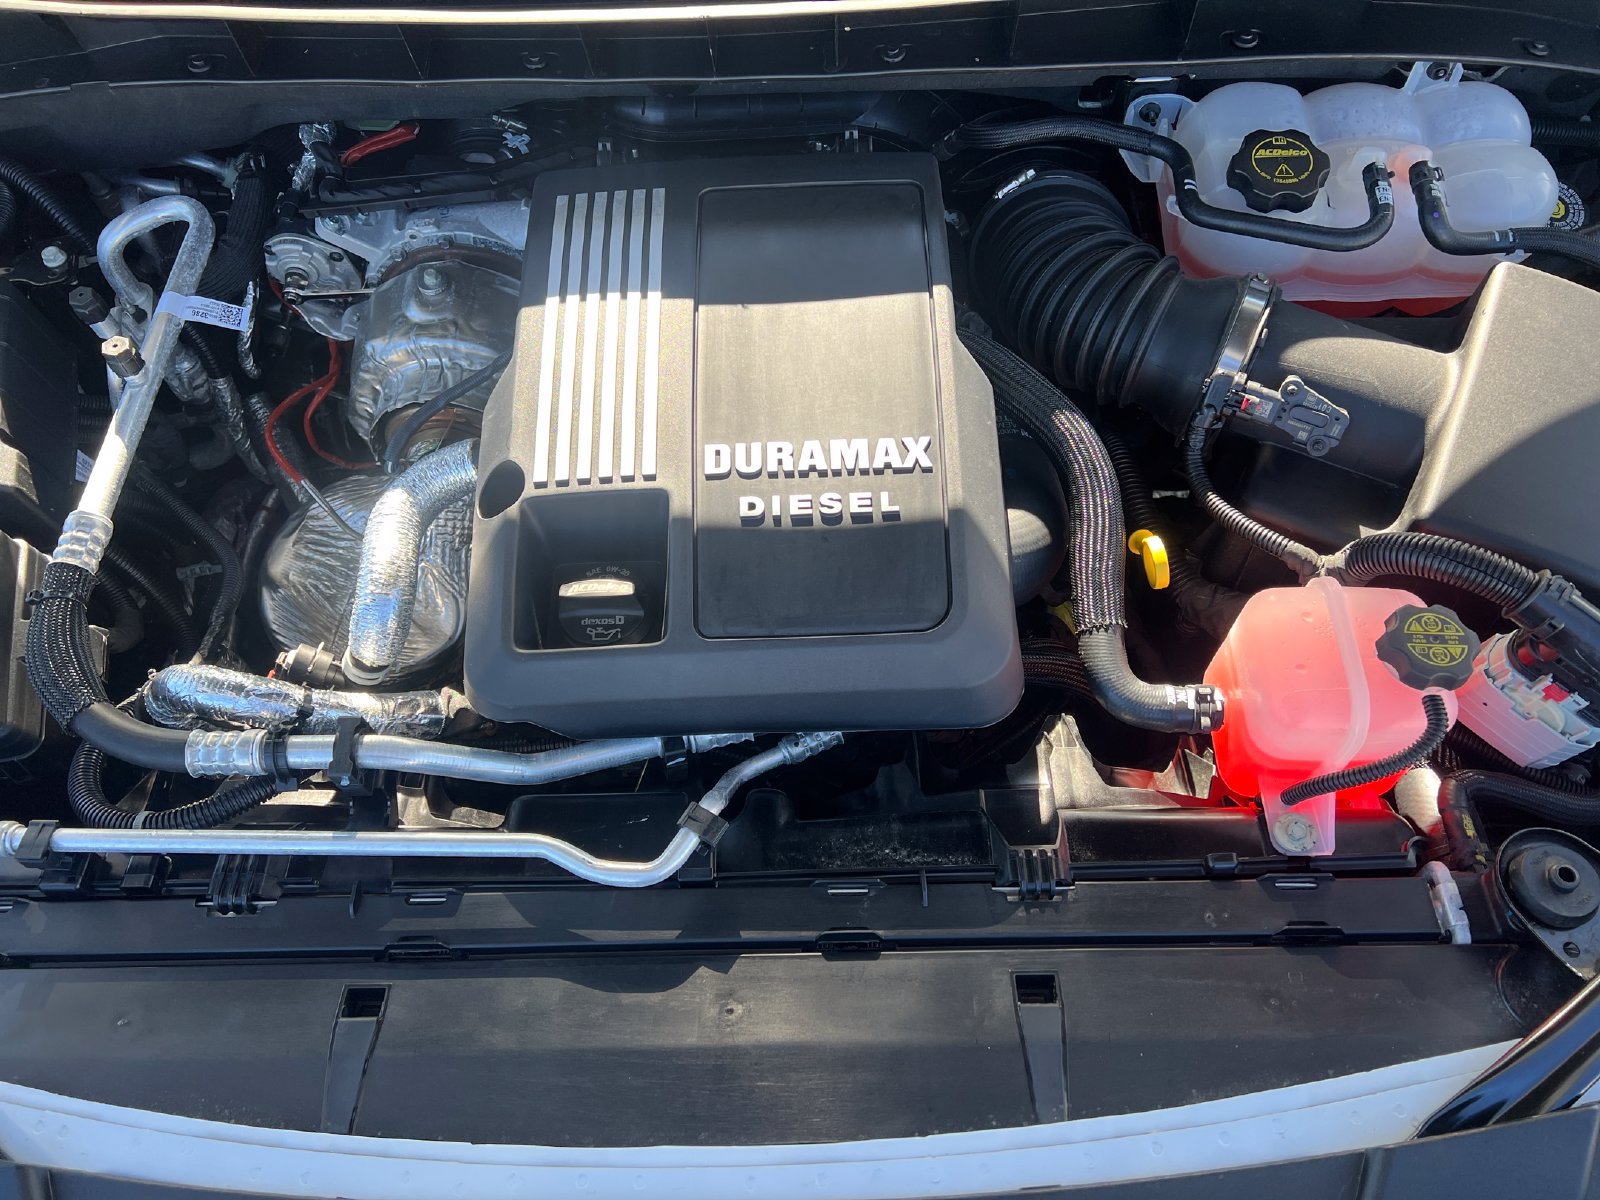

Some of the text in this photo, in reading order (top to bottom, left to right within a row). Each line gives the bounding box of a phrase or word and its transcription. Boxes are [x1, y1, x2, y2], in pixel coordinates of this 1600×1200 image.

[1256, 148, 1308, 157] ACDelco
[704, 436, 933, 479] DURAMAX
[739, 491, 901, 526] DIESEL
